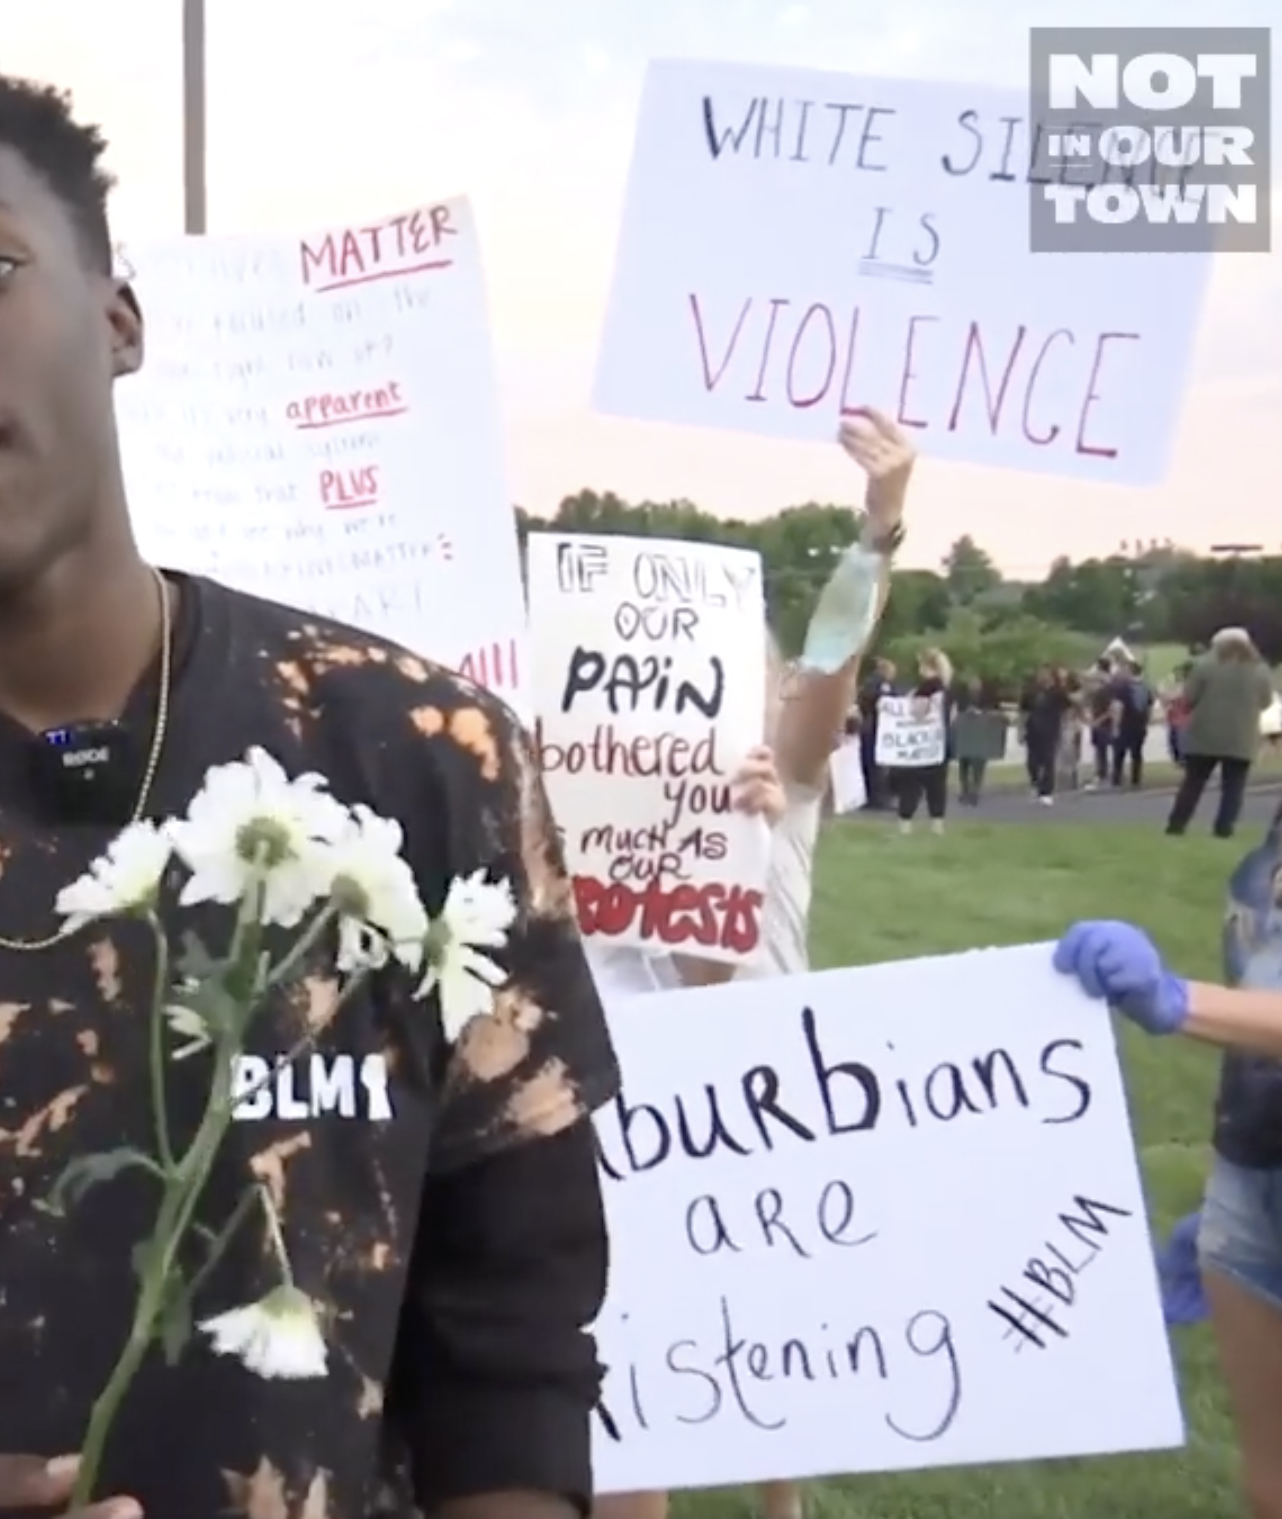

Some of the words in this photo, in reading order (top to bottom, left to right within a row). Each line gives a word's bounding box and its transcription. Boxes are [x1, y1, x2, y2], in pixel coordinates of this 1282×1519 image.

[702, 95, 896, 172] WHITE
[300, 204, 458, 284] MATTER
[862, 207, 941, 267] IS
[285, 381, 402, 422] apparent
[688, 293, 1141, 458] VIOLENCE
[320, 464, 380, 502] PLUS
[557, 542, 608, 592] IF
[634, 552, 756, 611] ONLY
[614, 602, 699, 642] OUR
[534, 716, 725, 777] bothered
[664, 780, 732, 831] you
[678, 827, 728, 861] AS
[987, 1194, 1132, 1354] #BLM
[597, 1296, 961, 1441] istening
